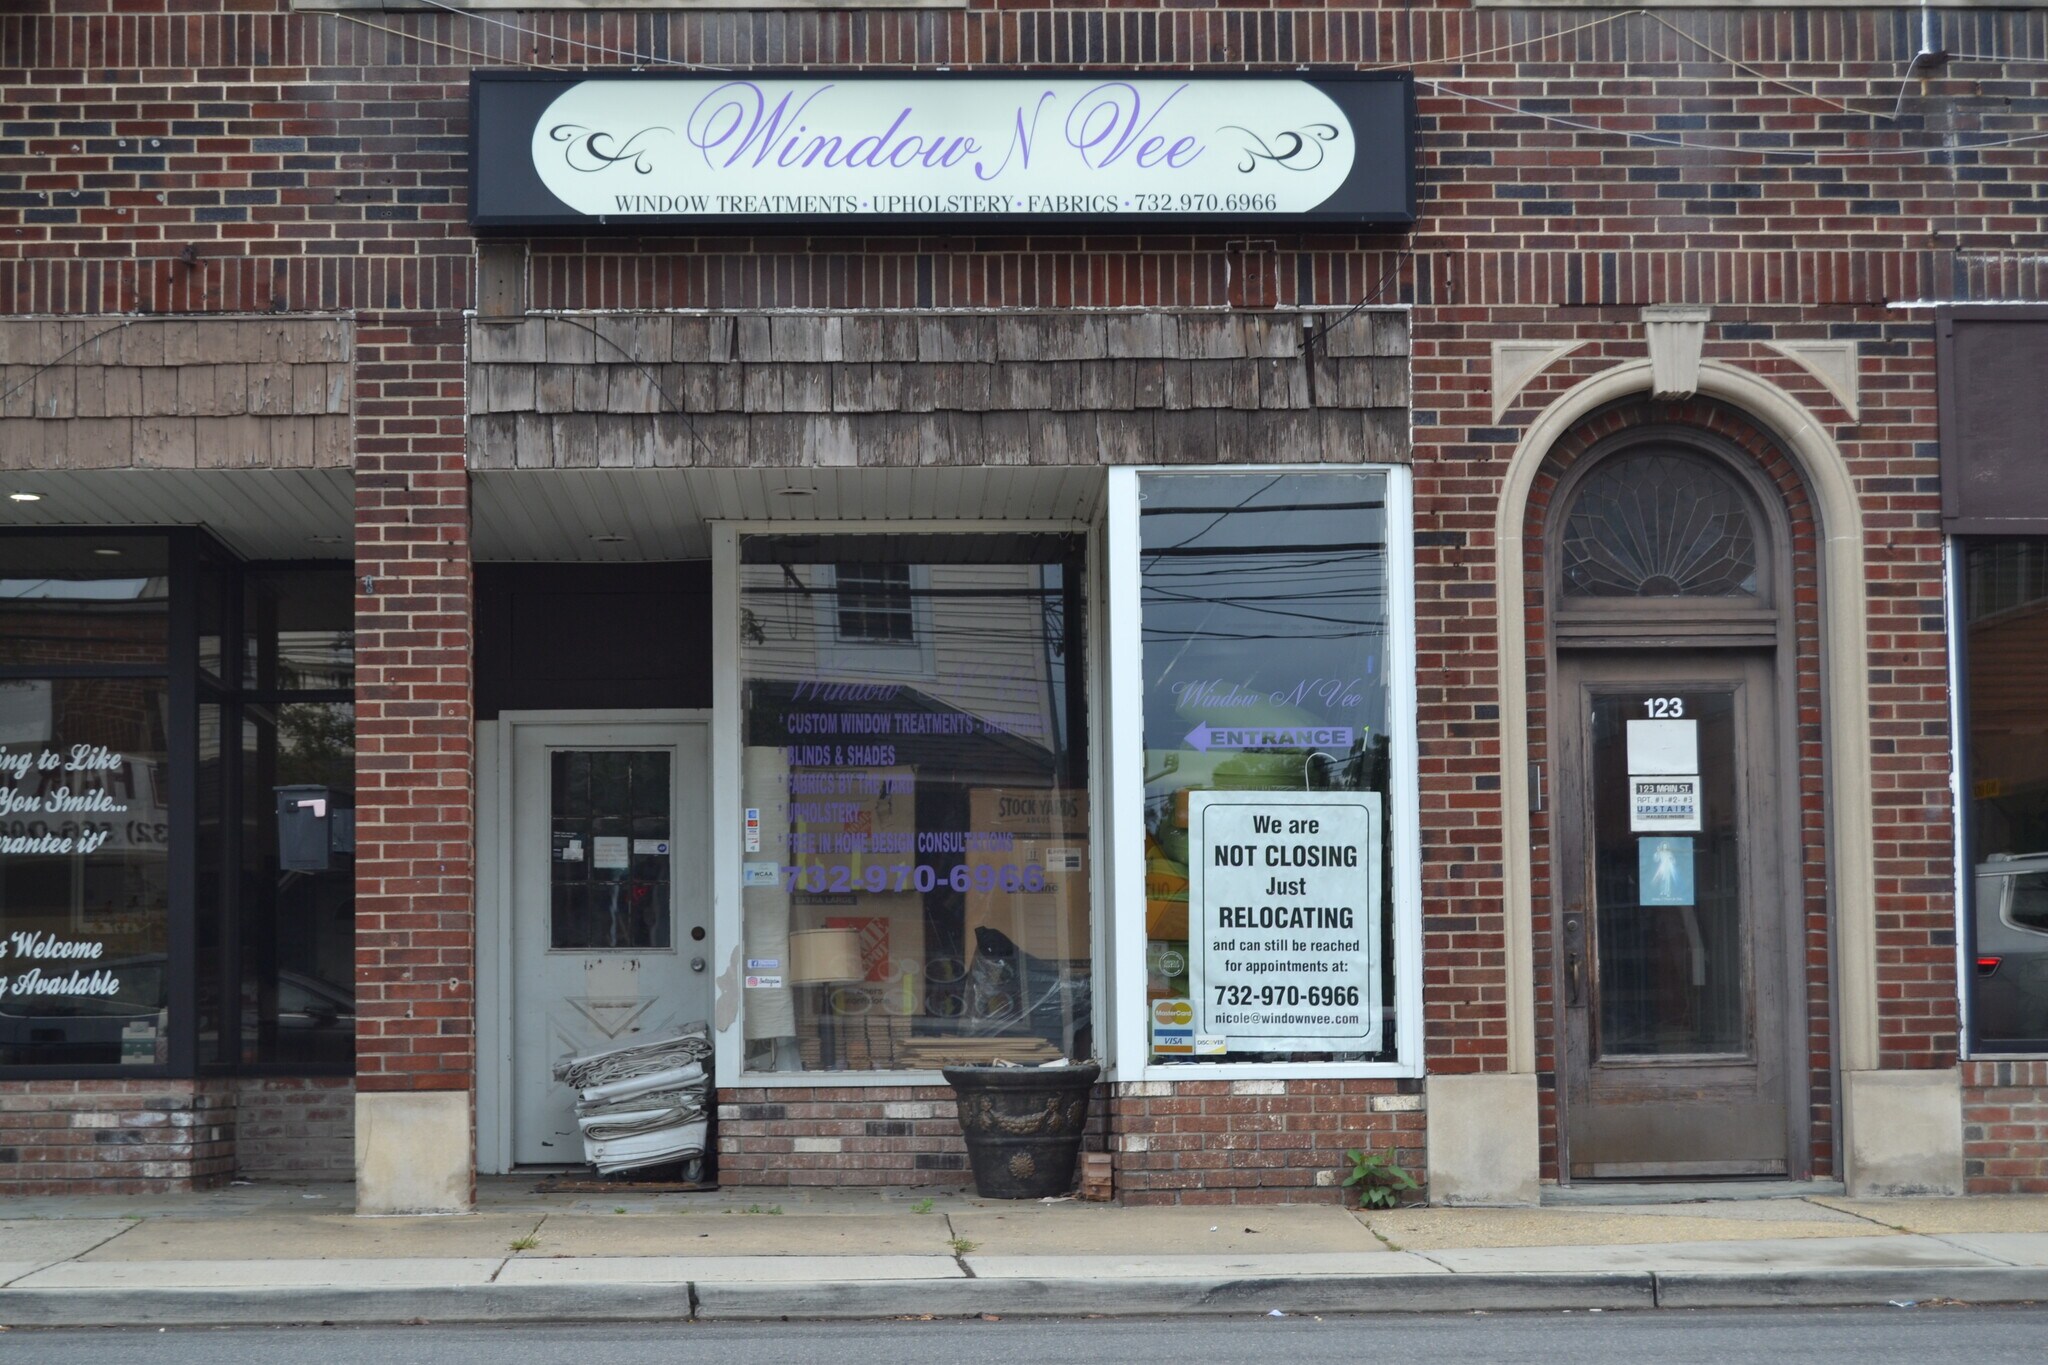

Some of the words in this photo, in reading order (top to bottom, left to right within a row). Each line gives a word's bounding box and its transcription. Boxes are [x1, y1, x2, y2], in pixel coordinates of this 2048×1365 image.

[687, 81, 982, 171] Window
[975, 90, 1057, 181] N
[1065, 81, 1206, 171] Vee
[614, 195, 709, 213] WINDOW
[716, 195, 858, 213] TREATMENTS
[873, 195, 1014, 213] UPHOLSTERY
[1027, 195, 1118, 213] FABRICS
[1135, 193, 1277, 212] 732.970.6966
[1171, 680, 1261, 709] Window
[1317, 680, 1364, 708] Vee
[1643, 697, 1683, 718] 123
[787, 713, 838, 735] CUSTOM
[840, 713, 892, 735] WINDOW
[894, 713, 974, 735] TREATMENTS
[1210, 729, 1346, 746] ENTRANCE
[37, 748, 61, 771] to
[64, 744, 123, 771] Like
[787, 744, 831, 766] BLINDS
[834, 744, 845, 766] &
[847, 744, 896, 766] SHADES
[786, 773, 835, 795] FABRICS
[838, 773, 855, 795] BY
[856, 773, 882, 795] THE
[883, 773, 916, 795] YARD
[1639, 784, 1655, 793] 123
[1656, 784, 1678, 793] MAIN
[1679, 784, 1692, 793] ST.
[0, 786, 42, 816] You
[45, 785, 128, 813] Smile...
[998, 796, 1036, 818] STOCK
[1637, 796, 1653, 804] APT.
[1637, 805, 1694, 813] UPSTAIRS
[786, 802, 861, 824] UPHOLSTERY
[1253, 815, 1282, 834] We
[1288, 820, 1319, 834] are
[786, 832, 816, 854] FREE
[819, 832, 832, 854] IN
[834, 832, 869, 854] HOME
[872, 832, 915, 854] DESIGN
[918, 832, 1015, 854] CONSULTATIONS
[1214, 845, 1257, 868] NOT
[1264, 844, 1358, 868] CLOSING
[781, 864, 1045, 893] 732-970-6966
[1265, 876, 1306, 896] Just
[1218, 906, 1354, 930] RELOCATING
[11, 930, 103, 959] Welcome
[1213, 938, 1235, 952] and
[1239, 942, 1261, 952] can
[1264, 938, 1289, 952] still
[1292, 938, 1307, 952] be
[1310, 938, 1360, 952] reached
[1225, 959, 1242, 973] for
[1245, 960, 1328, 975] appointments
[1332, 960, 1348, 973] at:
[11, 967, 120, 995] Available
[1214, 985, 1359, 1006] 732-970-6966
[1214, 1011, 1360, 1026] nicole@windownvee.com
[1164, 1037, 1183, 1045] VISA
